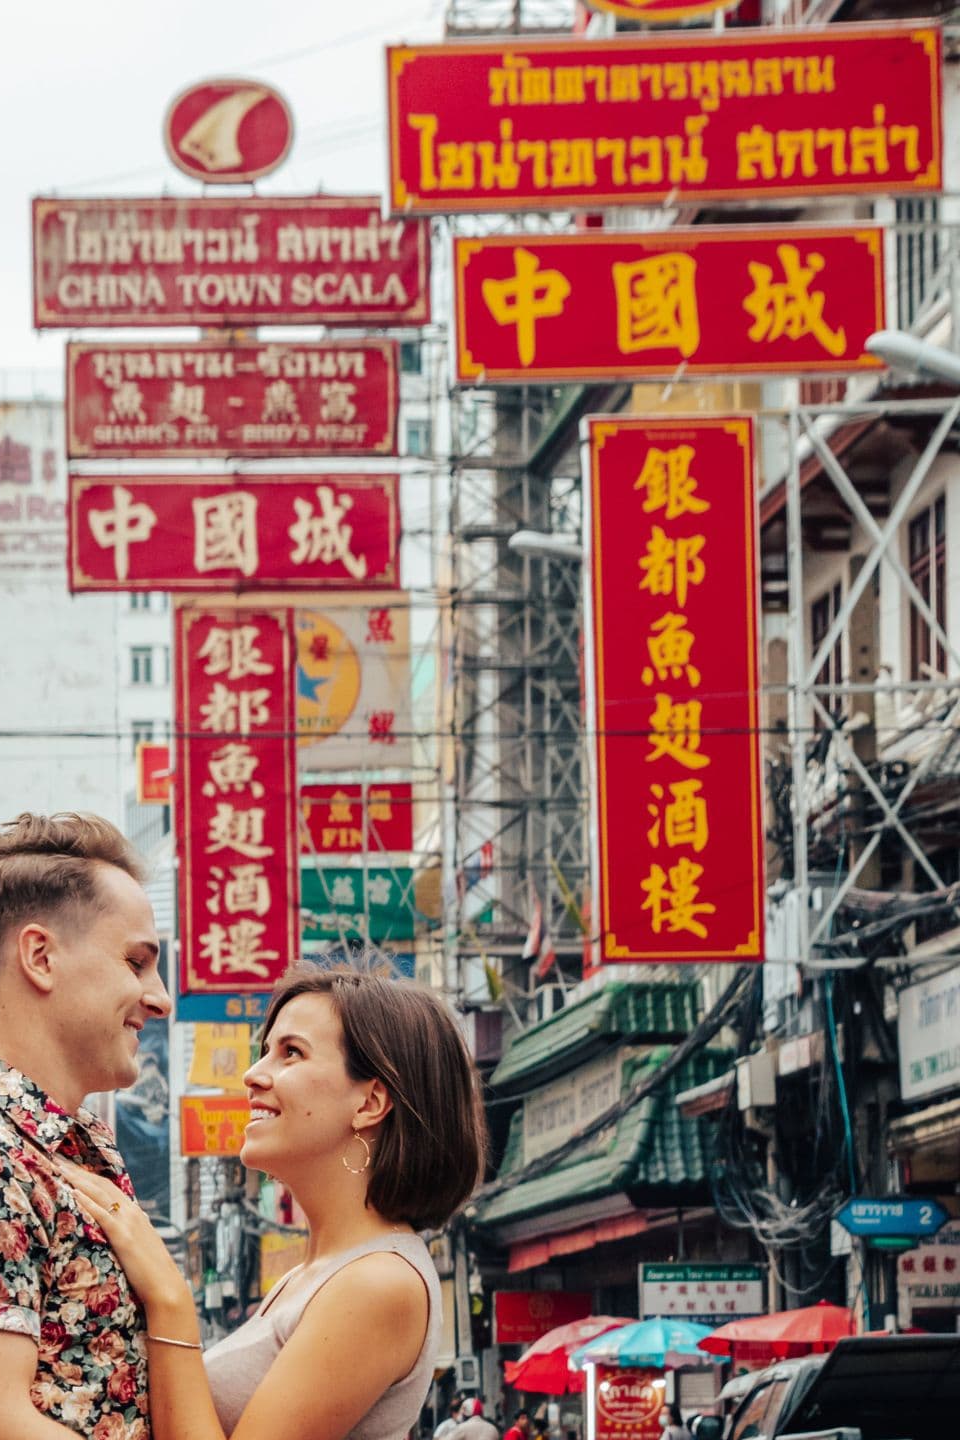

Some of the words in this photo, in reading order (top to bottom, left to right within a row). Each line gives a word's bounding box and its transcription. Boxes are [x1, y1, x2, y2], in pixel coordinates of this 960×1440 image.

[407, 112, 708, 191] ไชน่าทาวน์
[736, 104, 920, 181] สกาล่า
[57, 275, 166, 308] CHINA
[176, 274, 282, 306] TOWN
[290, 272, 408, 306] SCALA
[481, 244, 848, 367] 中國城
[185, 425, 219, 444] FIN
[315, 423, 369, 443] NEST
[26, 497, 66, 522] Ro
[89, 485, 367, 583] 中國城
[633, 444, 716, 939] 銀都魚翅酒樓
[197, 625, 280, 978] 銀都魚翅酒樓
[226, 997, 265, 1017] SE
[919, 1205, 933, 1226] 2
